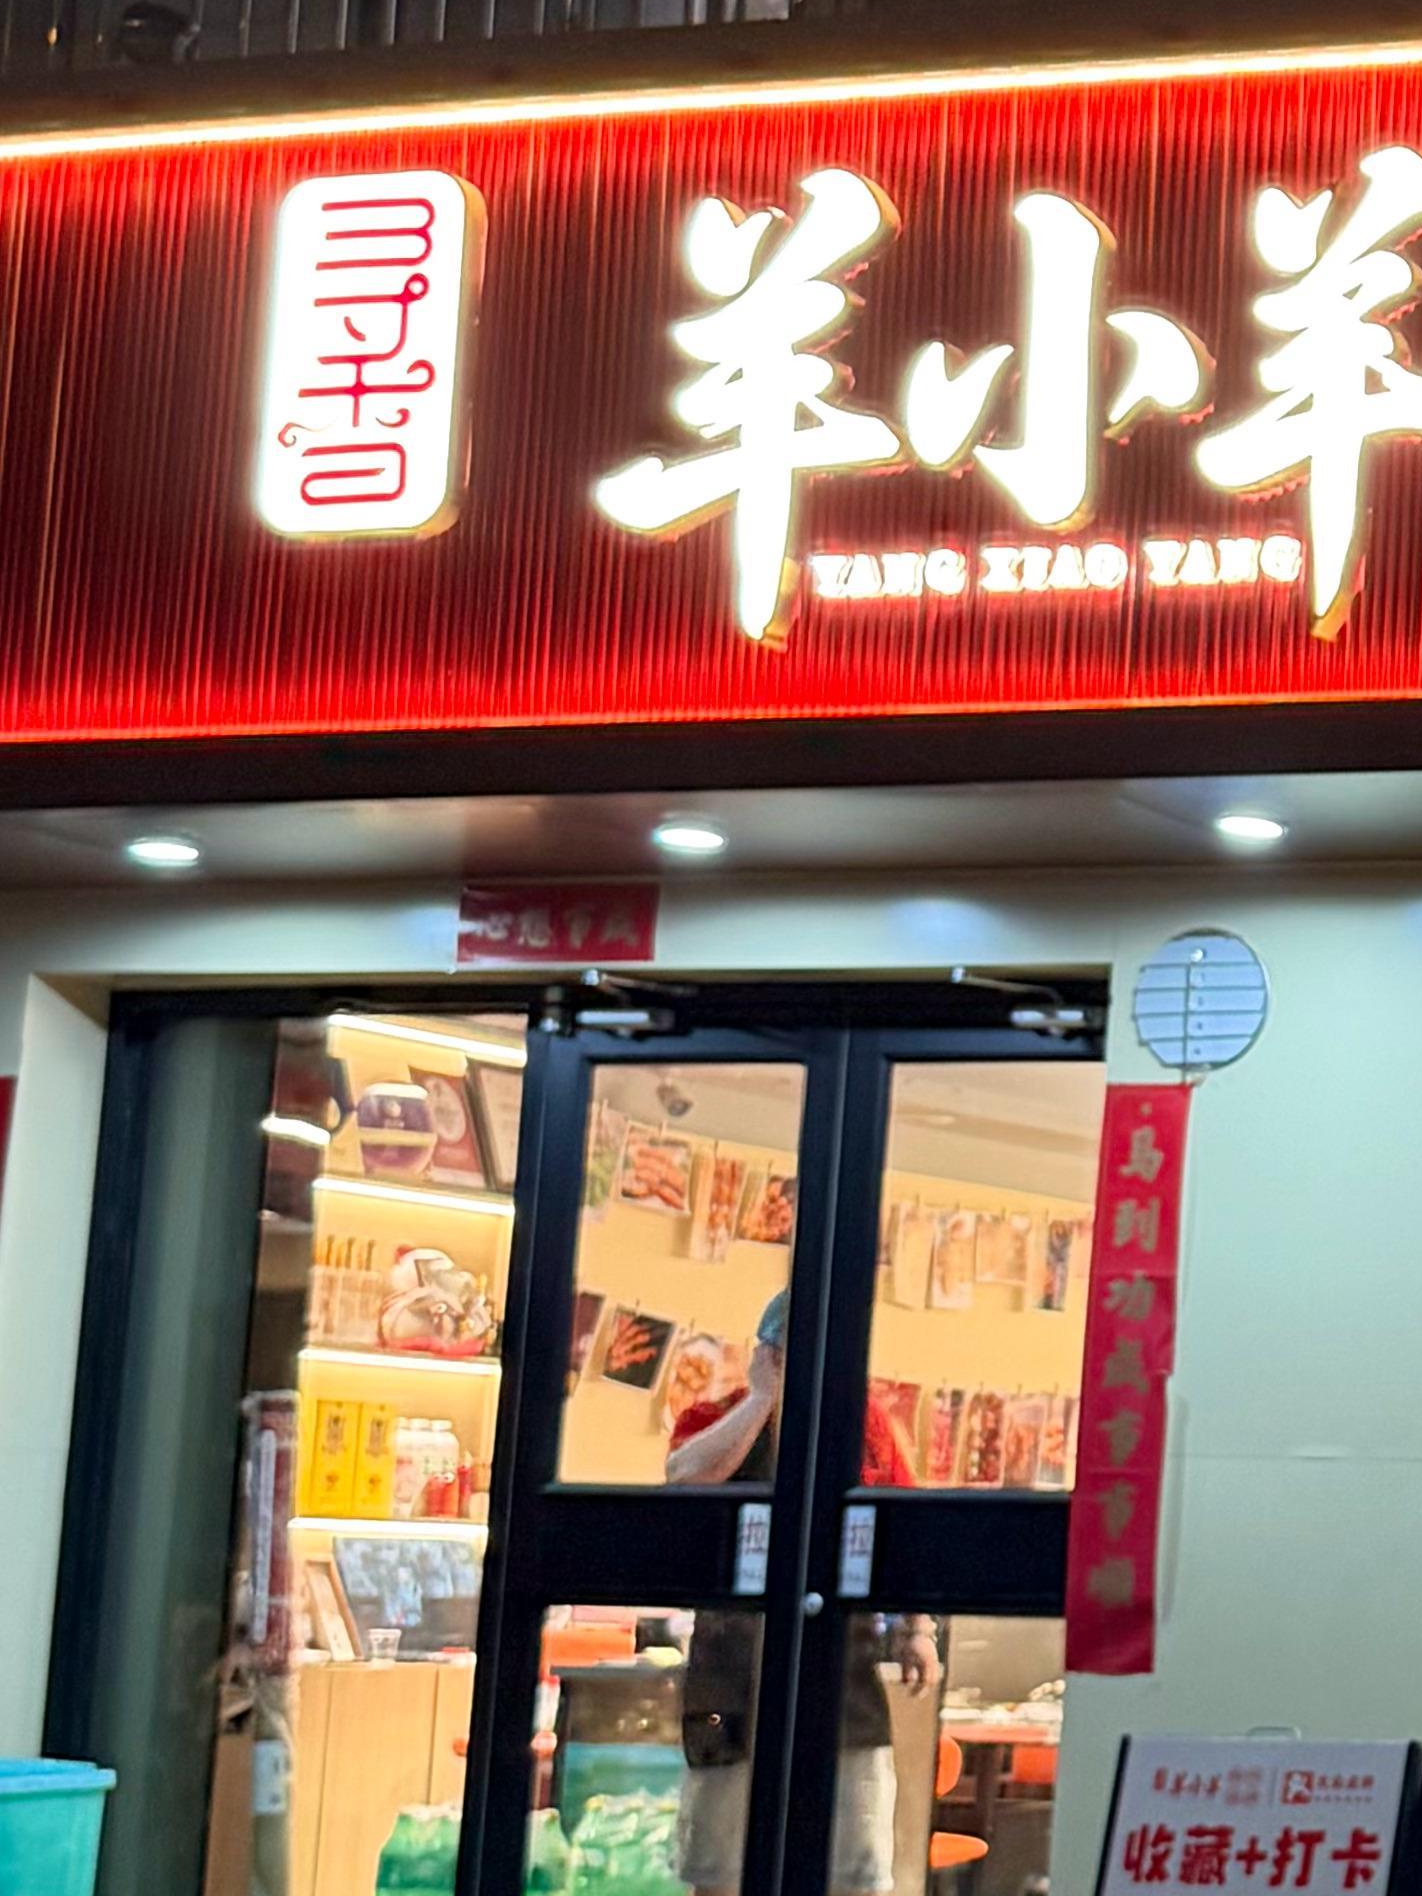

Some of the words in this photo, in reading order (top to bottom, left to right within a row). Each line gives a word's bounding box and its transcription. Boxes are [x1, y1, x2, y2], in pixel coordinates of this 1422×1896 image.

[808, 548, 967, 598] YANG
[979, 542, 1129, 592] XIAO
[1144, 535, 1302, 587] YANG
[1123, 1823, 1383, 1890] 收藏+打卡
